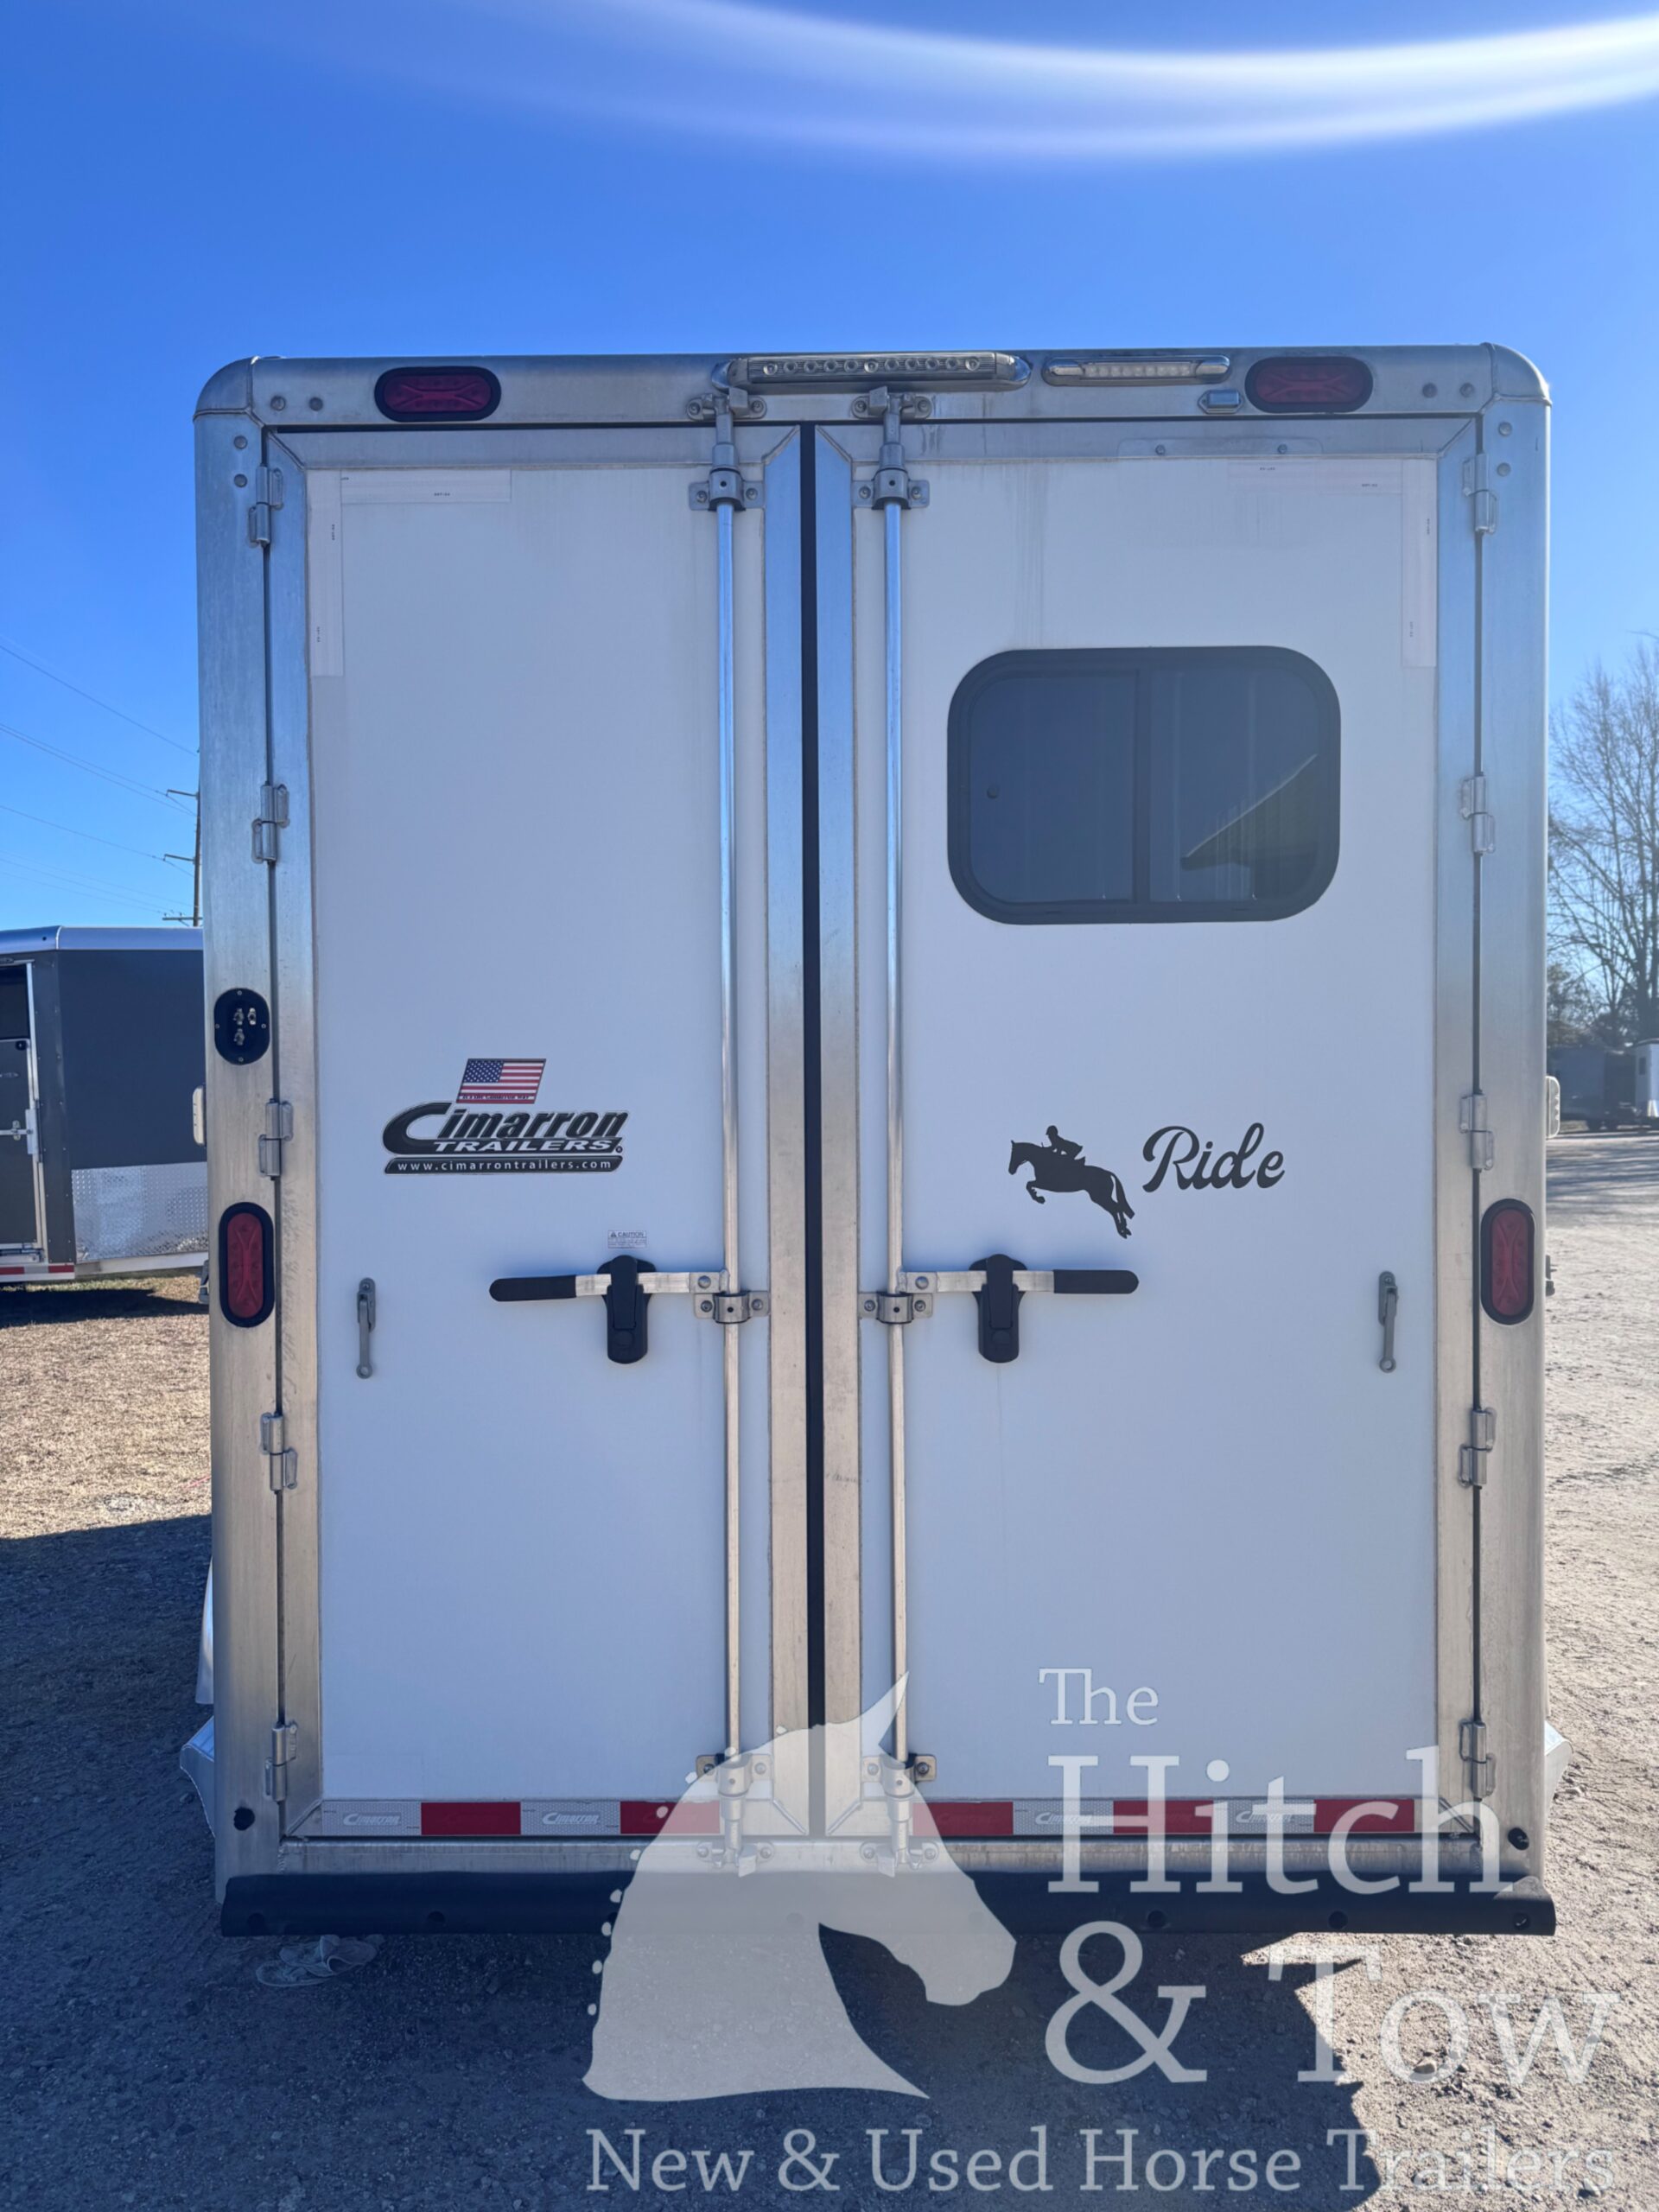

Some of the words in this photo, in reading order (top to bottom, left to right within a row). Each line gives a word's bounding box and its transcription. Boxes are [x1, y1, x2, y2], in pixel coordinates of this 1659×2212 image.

[382, 1102, 629, 1155] Cimarron
[434, 1140, 613, 1153] TRAILERS
[1142, 1122, 1285, 1192] Ride
[397, 1159, 612, 1171] www.cimarrontrailers.com
